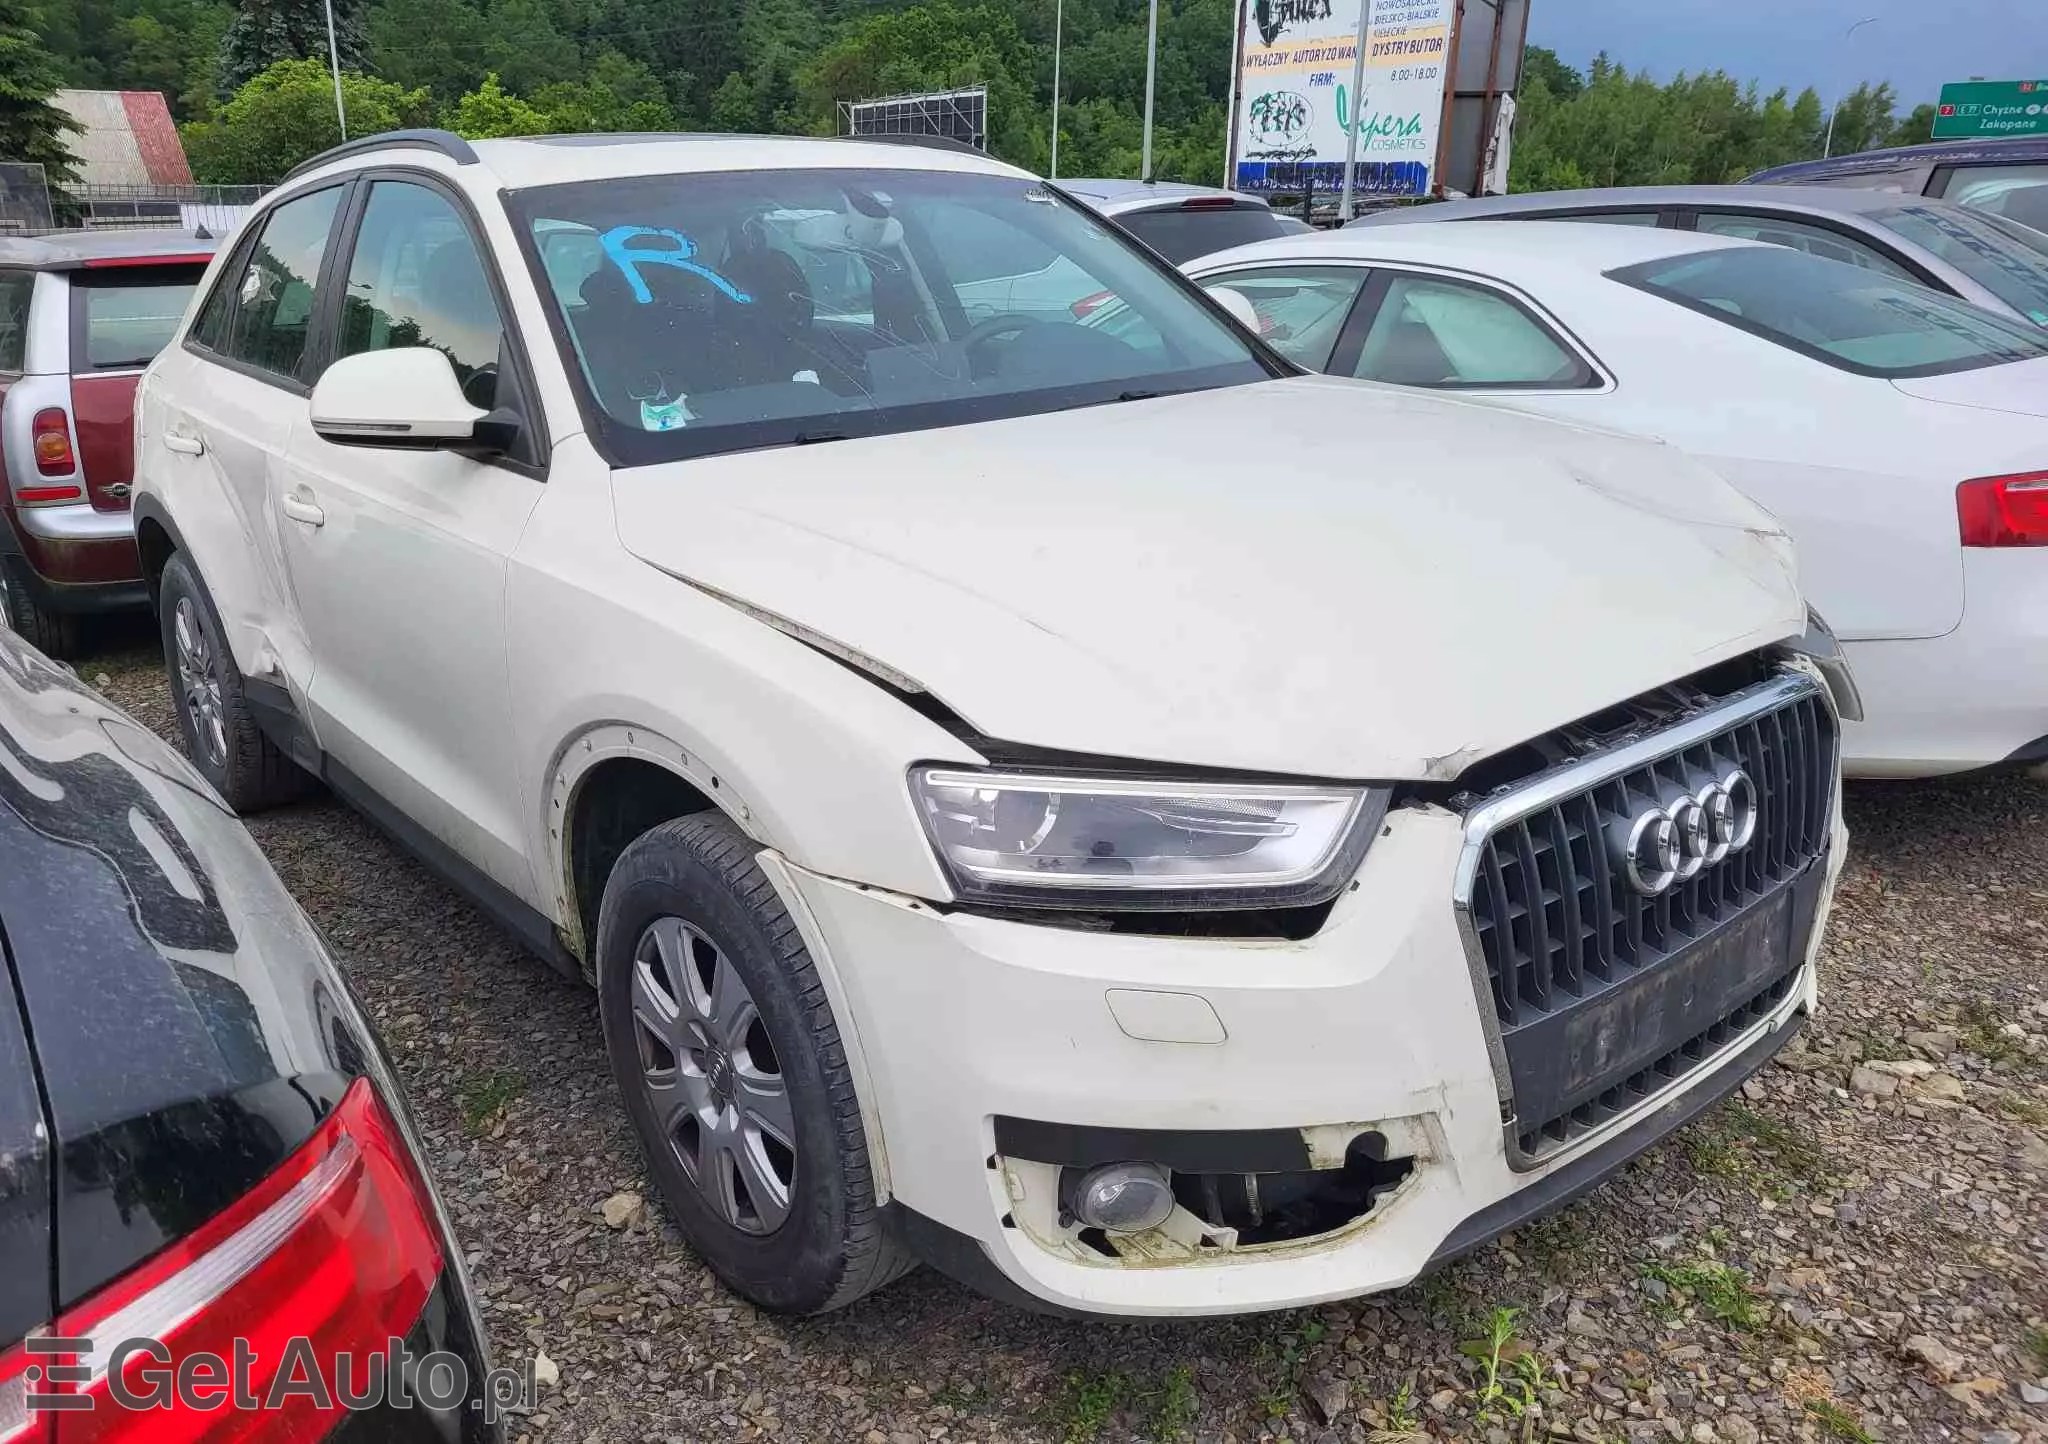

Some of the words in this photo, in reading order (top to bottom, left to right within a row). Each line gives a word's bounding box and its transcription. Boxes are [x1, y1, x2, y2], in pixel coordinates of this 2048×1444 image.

[1292, 46, 1358, 64] AUTORYZOWAN
[1372, 38, 1443, 57] DYSTRYBUTOR
[1309, 72, 1336, 87] FIRM:
[1979, 118, 2037, 131] Zakopane
[1371, 138, 1426, 151] COSMETICS
[600, 225, 752, 304] R
